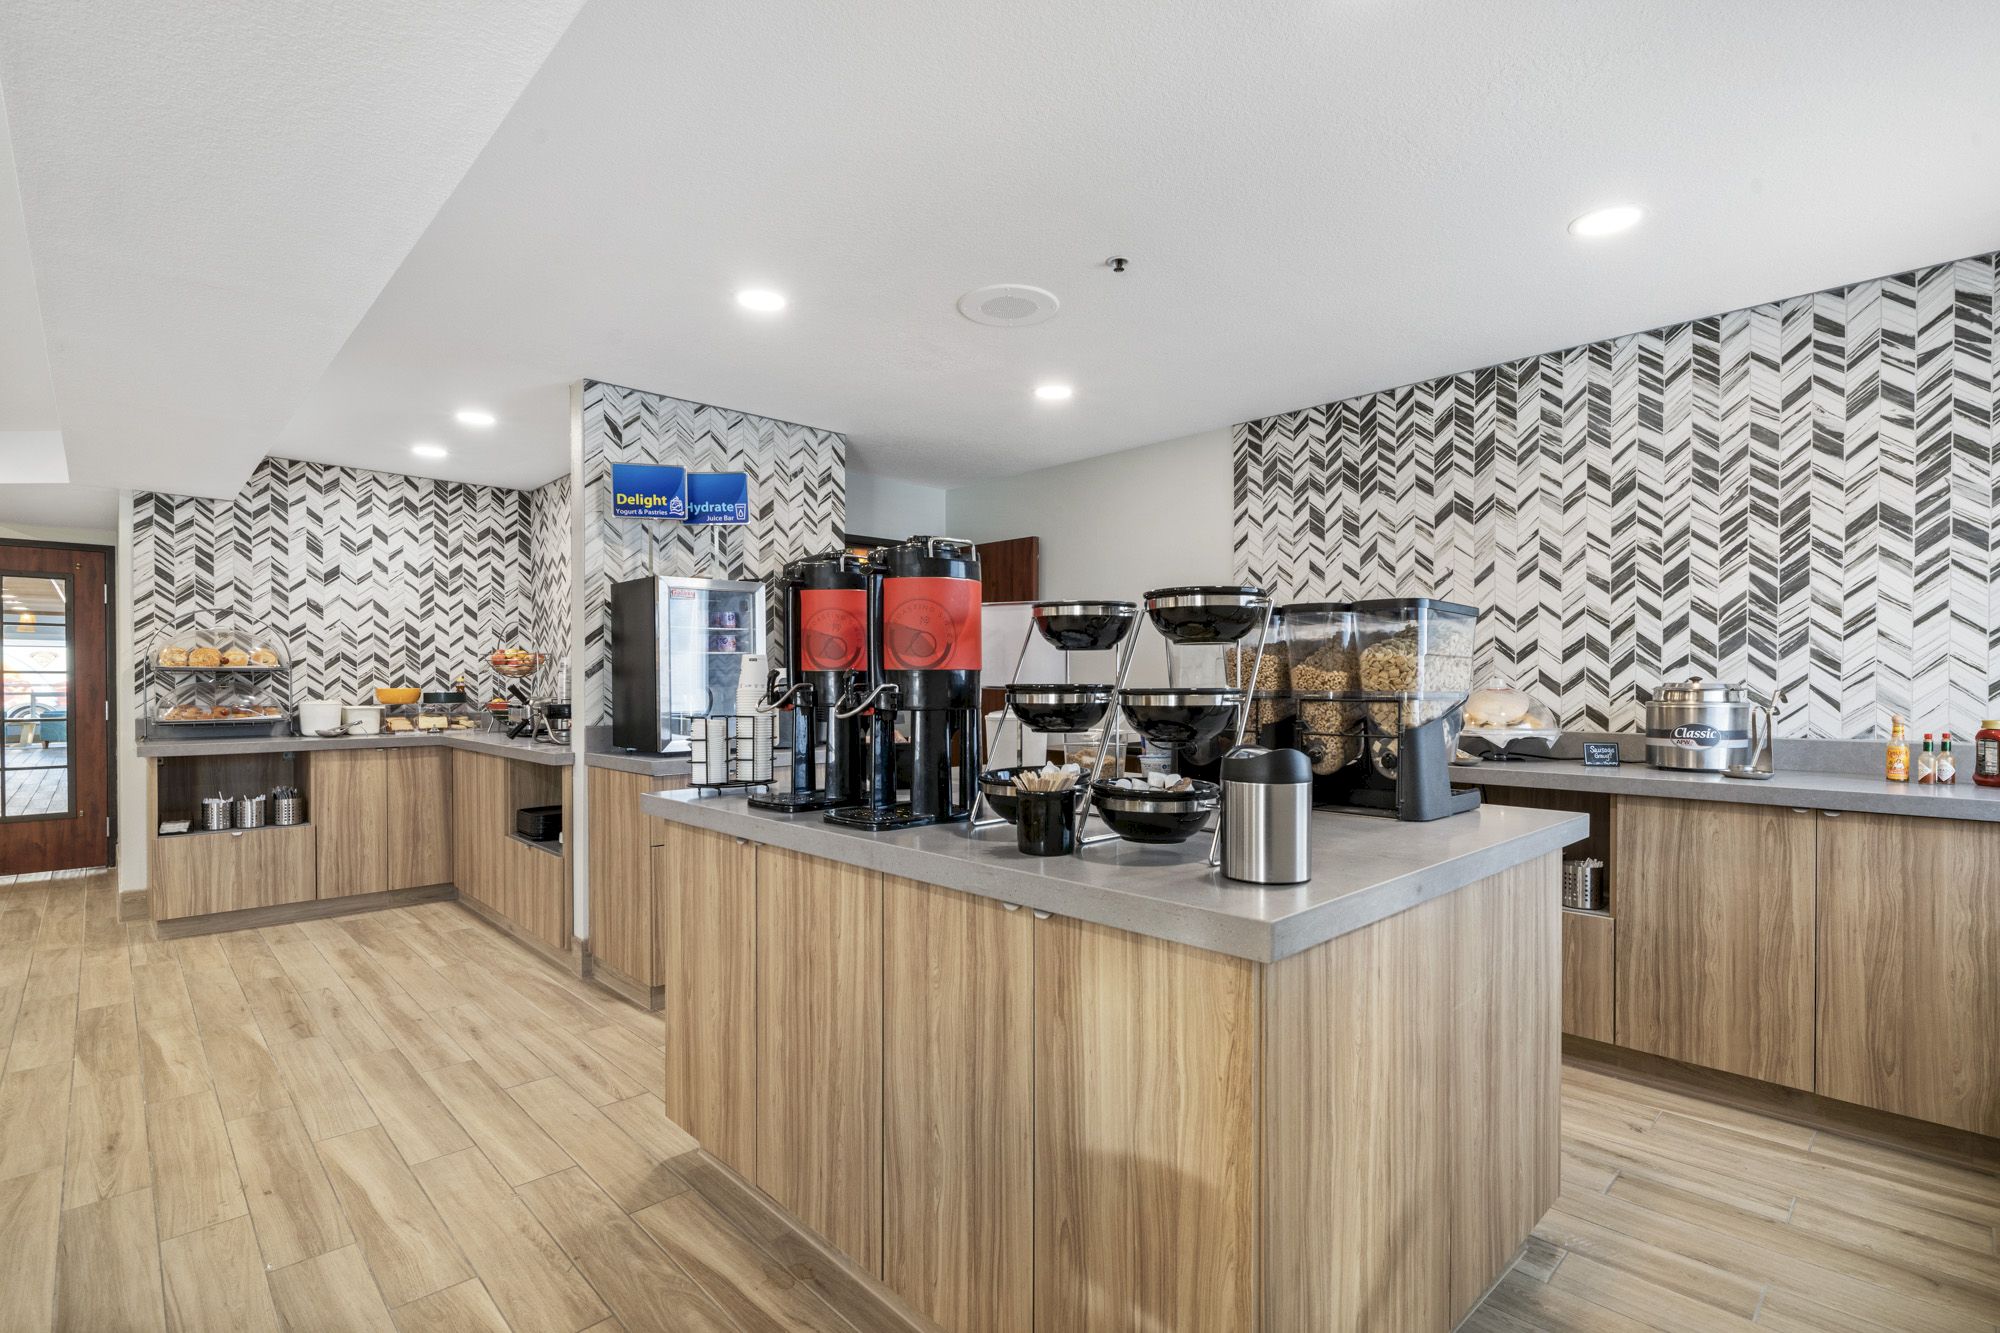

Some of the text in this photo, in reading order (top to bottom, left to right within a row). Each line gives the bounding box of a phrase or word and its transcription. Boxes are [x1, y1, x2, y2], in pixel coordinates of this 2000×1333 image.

[616, 493, 667, 508] Delight
[687, 501, 734, 514] Hydrate
[1674, 727, 1717, 739] Classic
